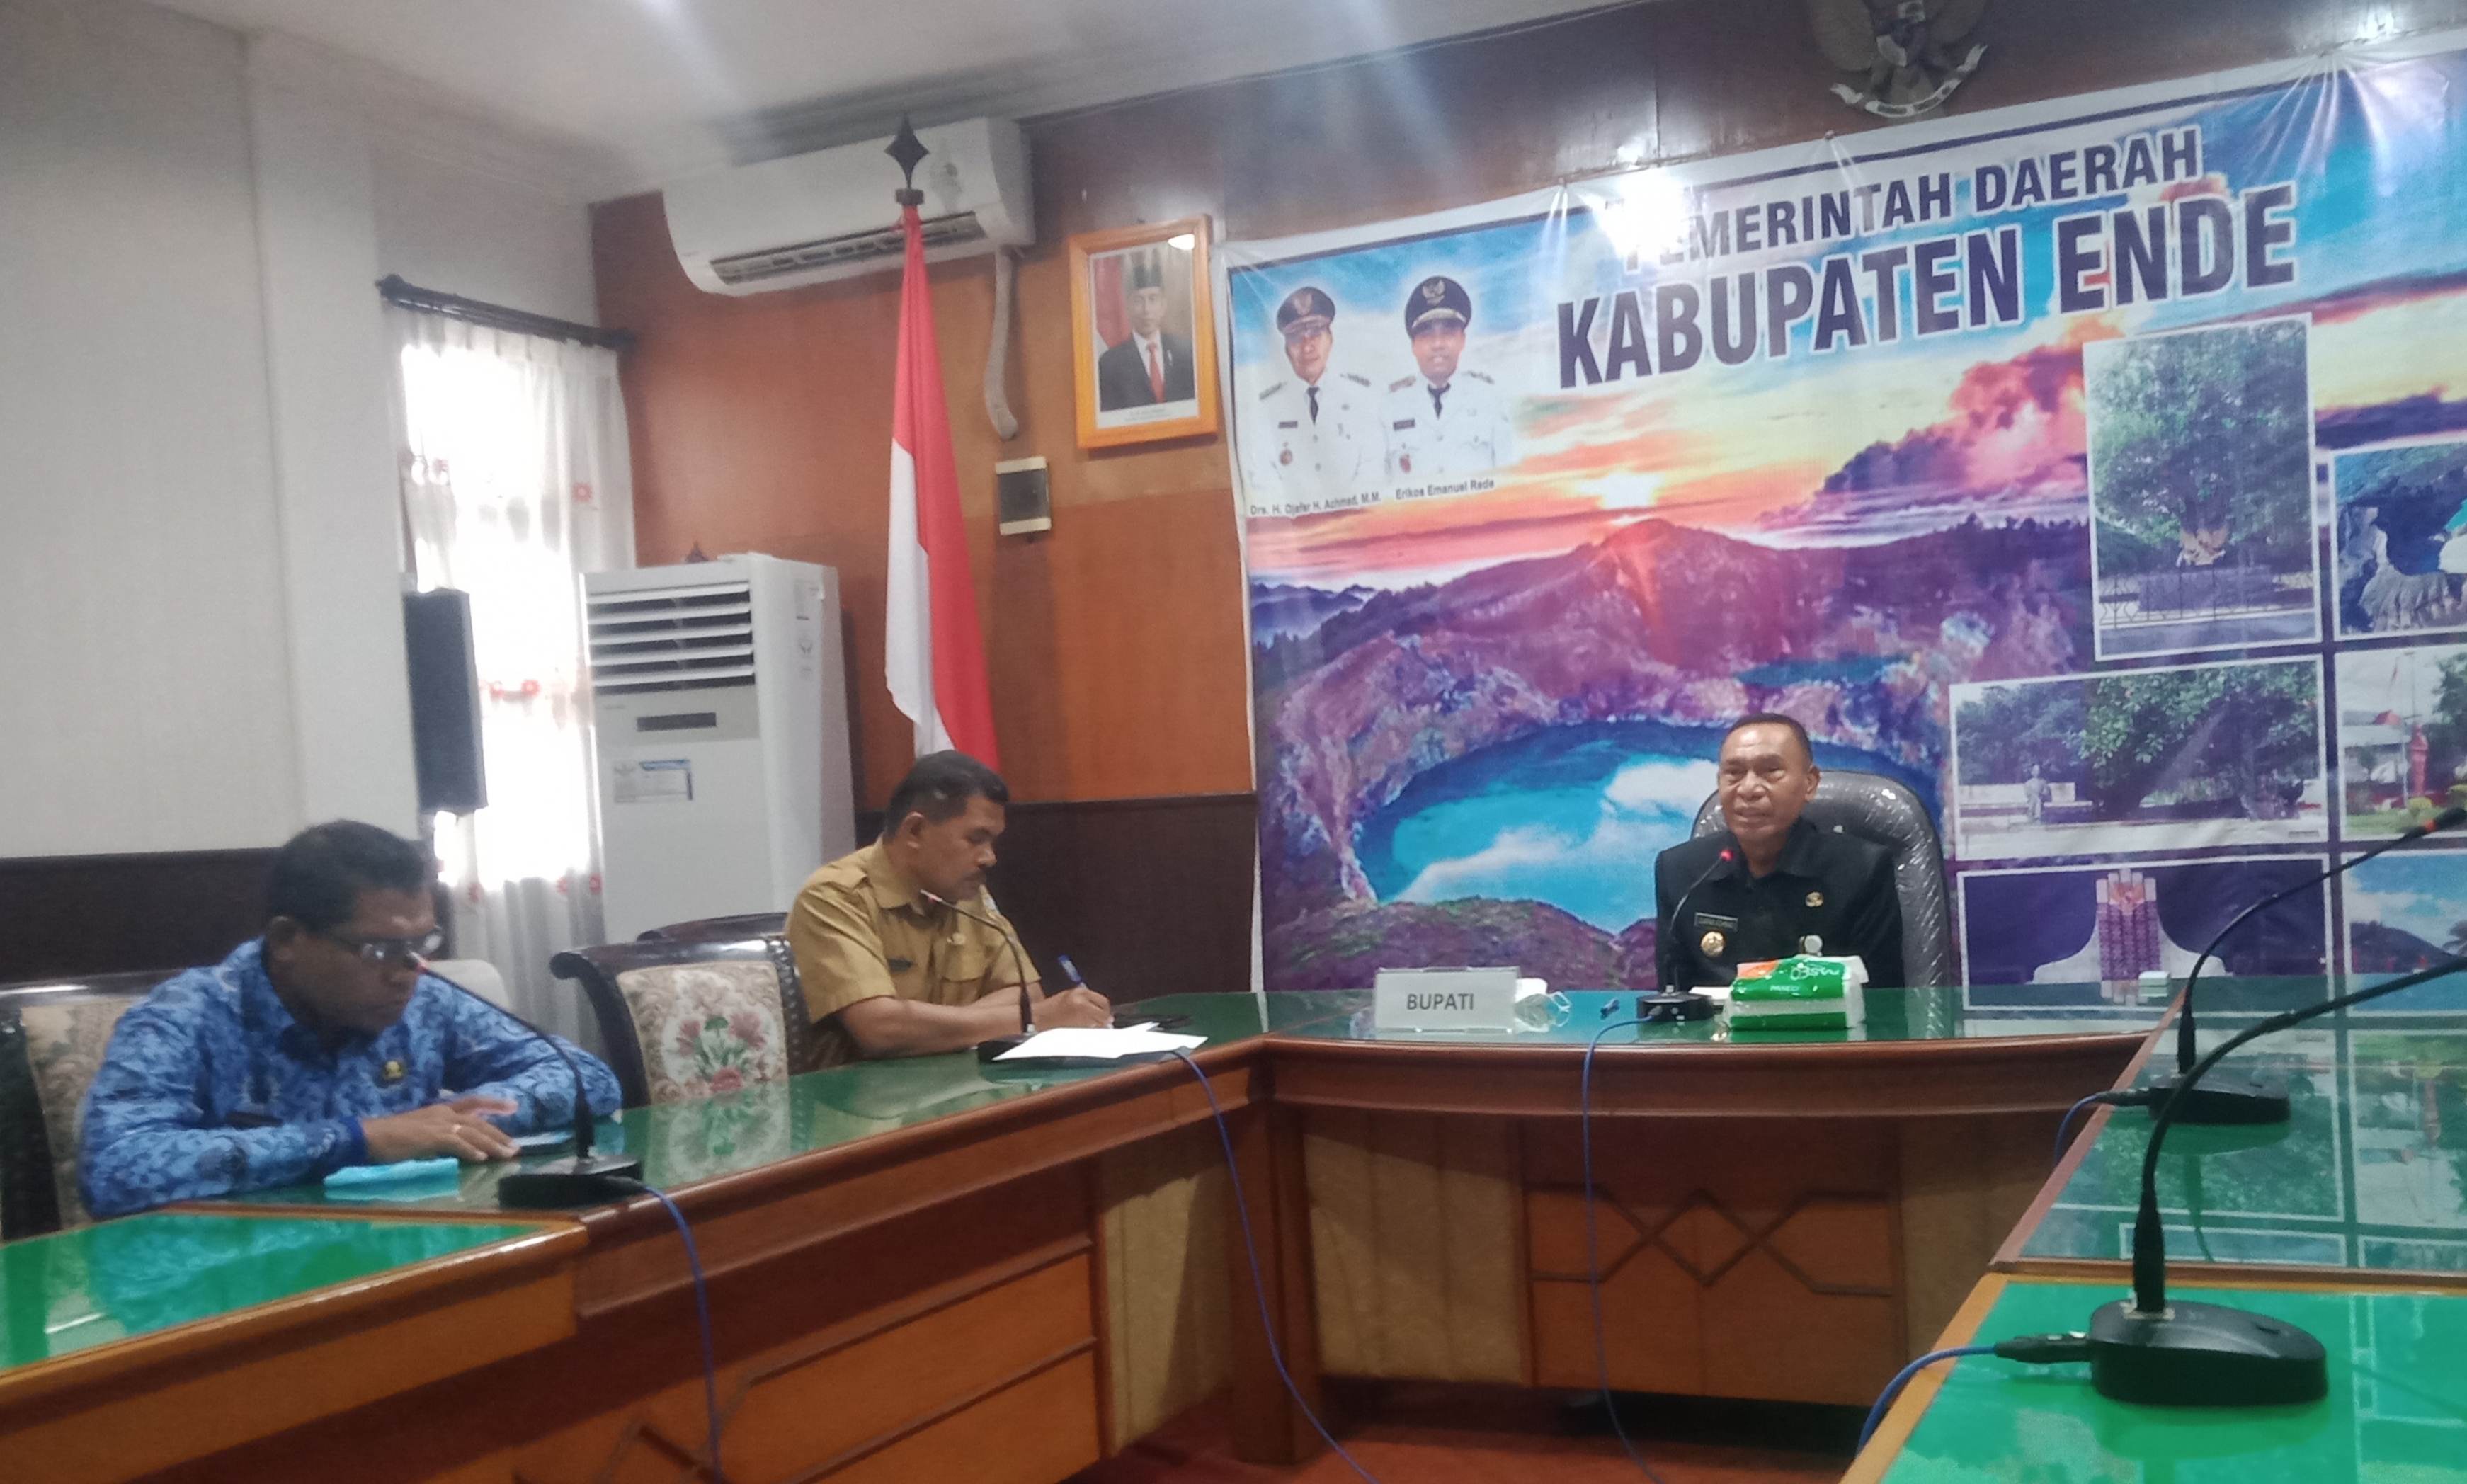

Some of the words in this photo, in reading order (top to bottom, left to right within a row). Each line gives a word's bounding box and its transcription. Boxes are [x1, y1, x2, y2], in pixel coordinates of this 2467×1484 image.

[1626, 172, 1952, 272] MERINTAH
[1975, 130, 2197, 210] DAERAH
[1559, 229, 2020, 387] KABUPATEN
[2058, 186, 2295, 314] ENDE
[1427, 481, 1467, 496] Emanuel
[1406, 993, 1475, 1010] BUPATI
